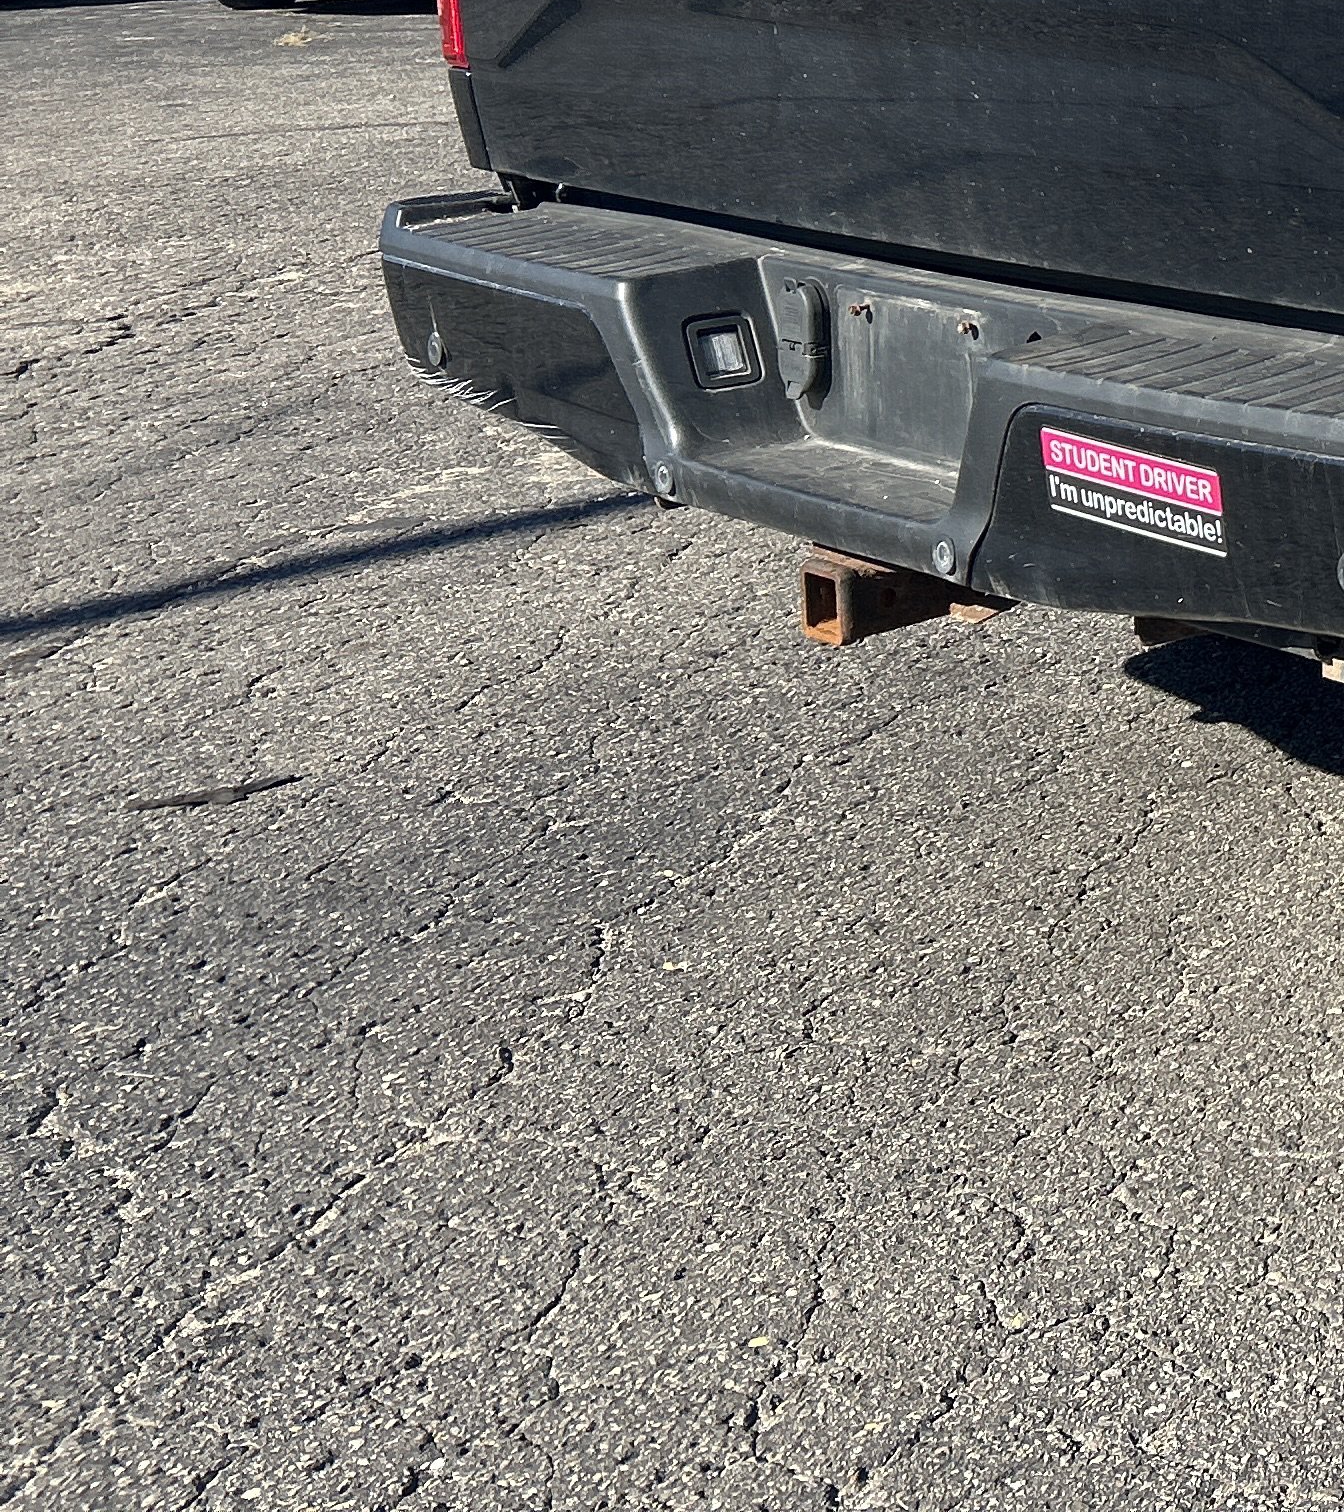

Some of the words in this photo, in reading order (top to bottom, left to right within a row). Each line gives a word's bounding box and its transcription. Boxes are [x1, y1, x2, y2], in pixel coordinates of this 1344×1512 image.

[1049, 439, 1137, 483] STUDENT
[1139, 462, 1213, 504] DRIVER
[1049, 474, 1079, 504] I'm
[1080, 488, 1223, 544] unpredictable!
